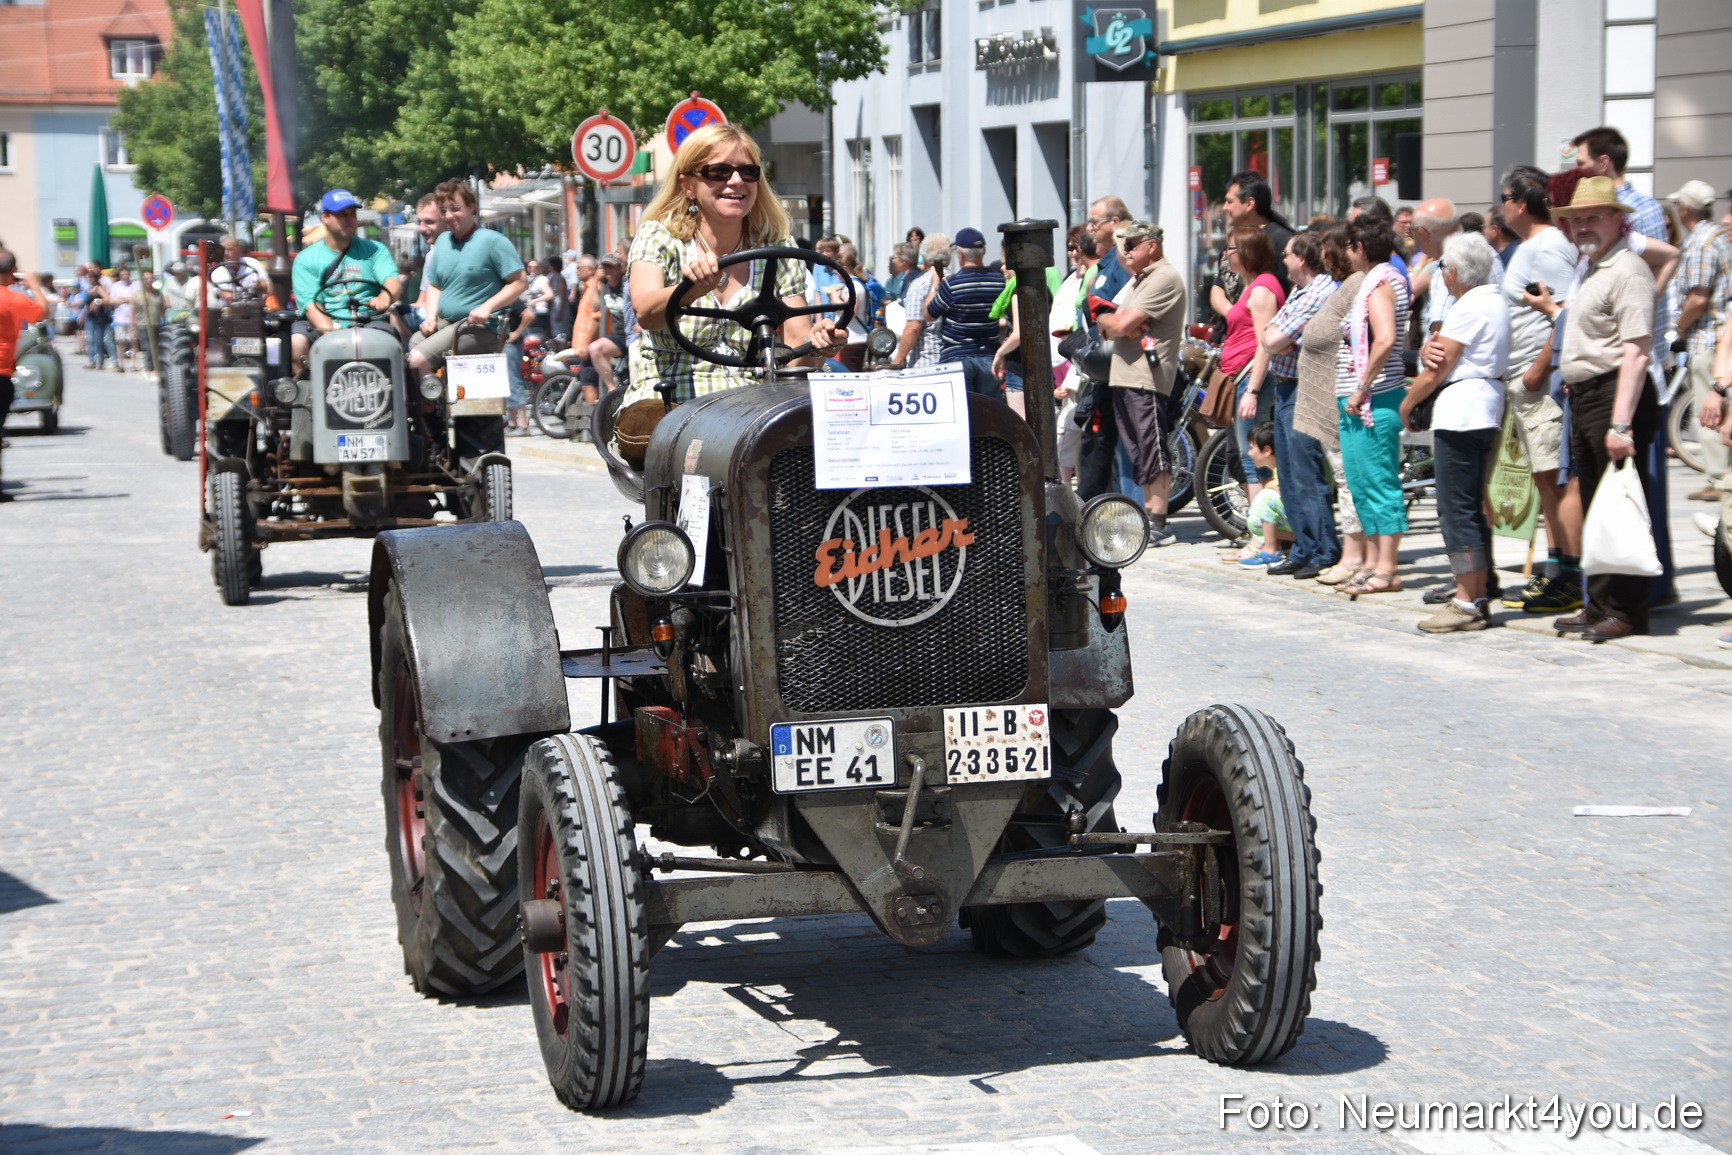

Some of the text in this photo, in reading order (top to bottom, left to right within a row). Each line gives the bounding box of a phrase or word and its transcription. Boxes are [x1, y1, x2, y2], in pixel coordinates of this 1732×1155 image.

[1105, 19, 1134, 56] G2
[586, 132, 622, 163] 30
[476, 364, 495, 374] 558
[887, 391, 937, 416] 550
[342, 448, 357, 460] AW
[360, 447, 375, 459] 57
[347, 436, 364, 448] NM
[813, 517, 975, 588] Eicher
[843, 501, 947, 605] DIESEL
[779, 744, 787, 754] D
[796, 725, 836, 755] NM
[796, 754, 882, 786] EE 41
[947, 745, 1050, 776] 233521
